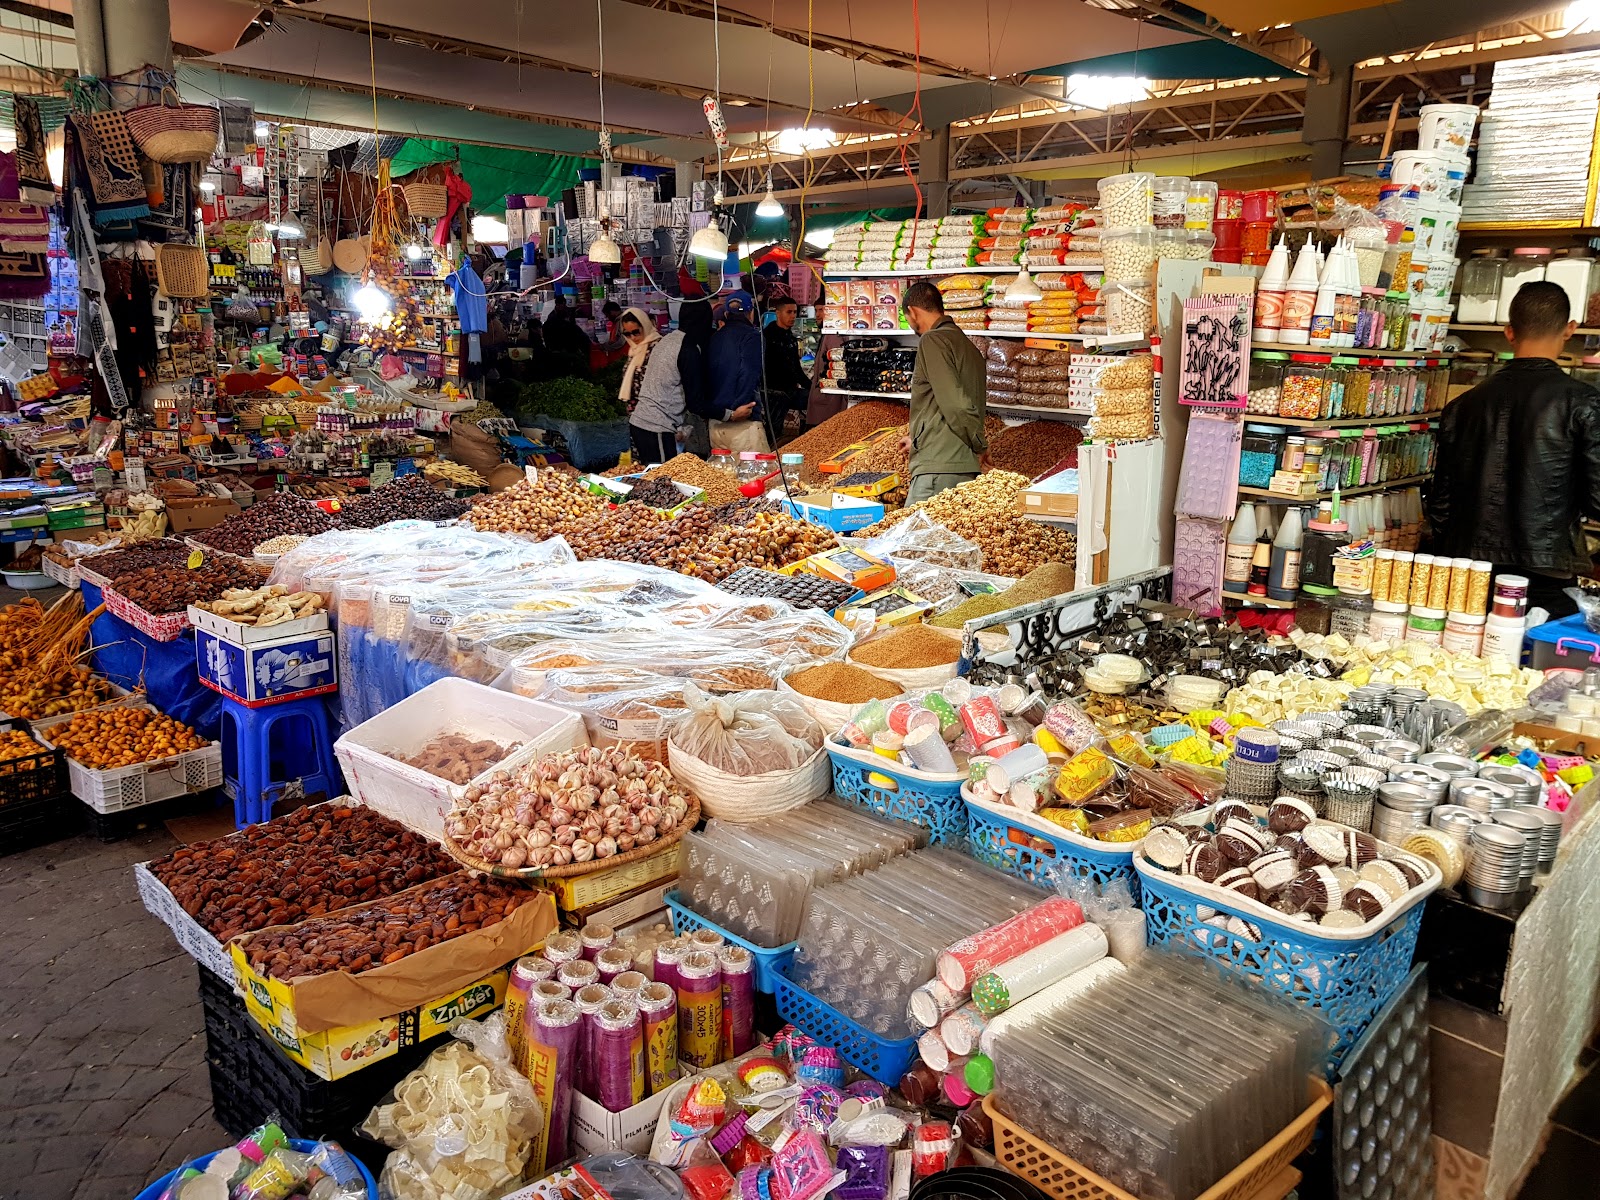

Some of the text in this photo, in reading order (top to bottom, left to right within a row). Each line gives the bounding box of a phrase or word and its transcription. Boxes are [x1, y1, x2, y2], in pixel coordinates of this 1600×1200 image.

[390, 595, 410, 603] GOYA
[264, 695, 285, 704] AGLIO
[315, 686, 328, 694] AJO
[434, 986, 492, 1025] Zniber
[696, 1005, 707, 1038] 300x45
[533, 1050, 549, 1097] FILM
[625, 1127, 642, 1139] FILM
